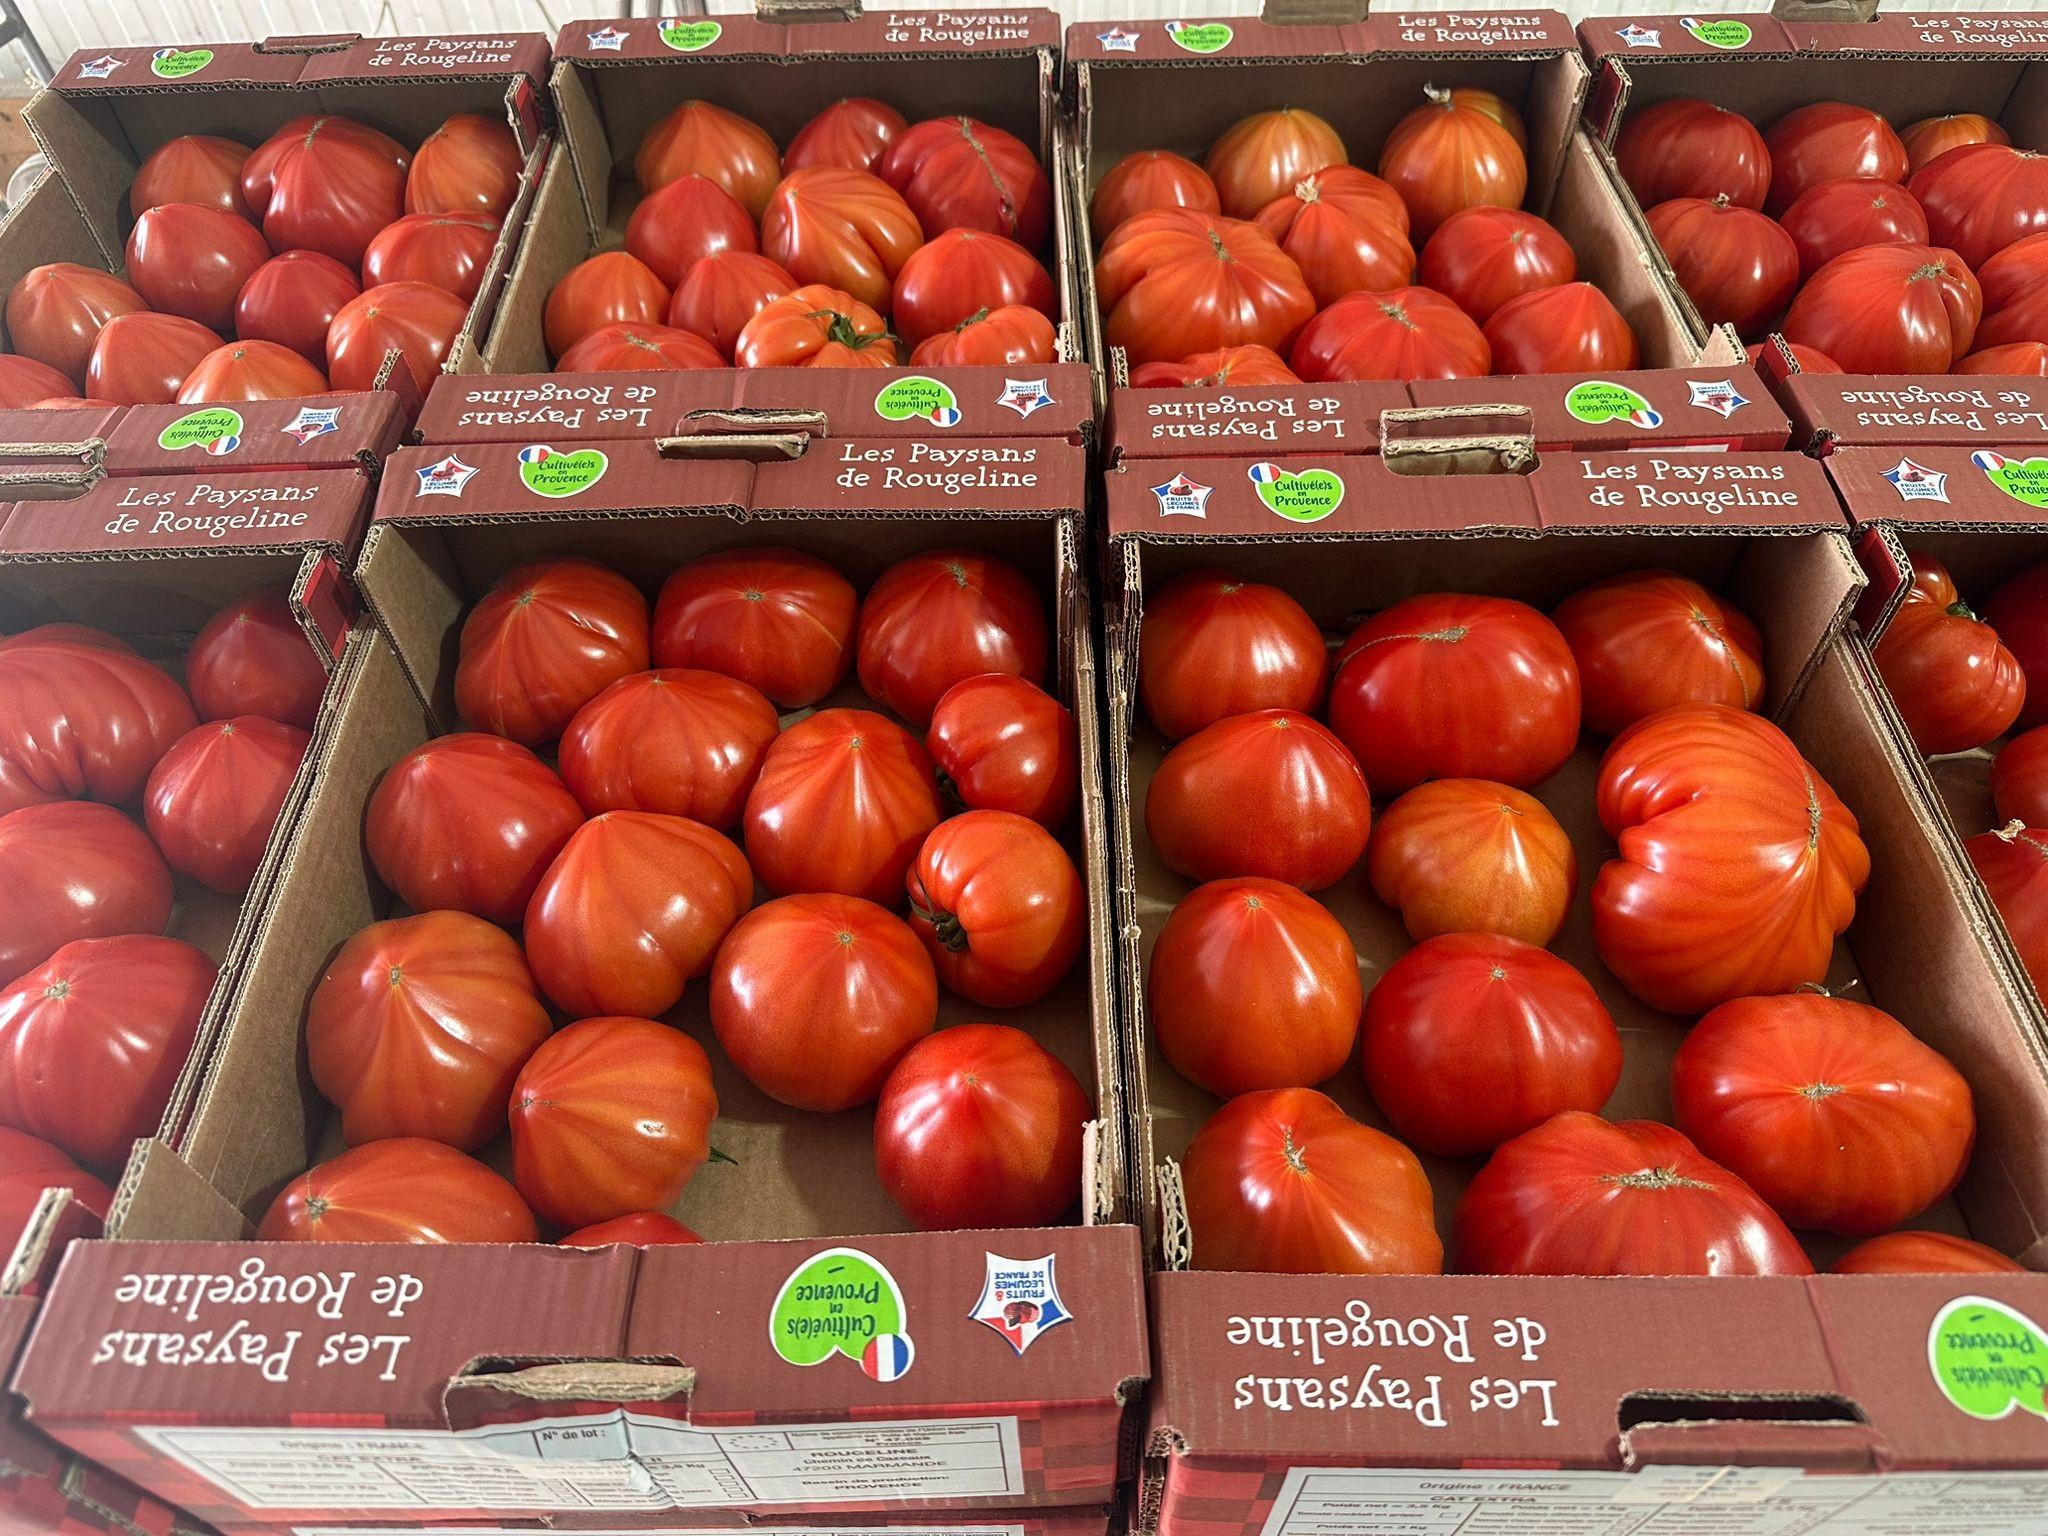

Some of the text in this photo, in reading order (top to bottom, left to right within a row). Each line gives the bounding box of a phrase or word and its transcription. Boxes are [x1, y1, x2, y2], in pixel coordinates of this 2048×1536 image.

[887, 13, 1029, 28] Les Paysans
[1398, 15, 1541, 29] Les Paysans
[1908, 16, 1950, 28] Les
[885, 26, 1030, 46] de Rougeline
[1401, 27, 1548, 46] de Rougeline
[1919, 31, 1945, 43] de
[374, 39, 518, 52] Les Paysans
[368, 50, 512, 68] de Rougeline
[465, 382, 657, 409] de Rougeline
[890, 388, 941, 398] Provence
[1575, 392, 1629, 402] Provence
[1840, 385, 2031, 410] de Rougeline
[458, 405, 652, 429] Les Paysans
[1147, 395, 1341, 421] de Rougeline
[180, 417, 234, 428] Provence
[1856, 408, 1987, 431] Paysans
[1151, 418, 1345, 441] Les Paysans
[839, 443, 1037, 468] Les Paysans
[532, 474, 589, 485] Provence
[836, 465, 1039, 495] de Rougeline
[1580, 459, 1785, 485] Les Paysans
[117, 484, 320, 510] Les Paysans
[1275, 495, 1332, 507] Provence
[1588, 483, 1800, 516] de Rougeline
[105, 509, 309, 540] de Rougeline
[995, 1271, 1044, 1280] DE FRANCE
[114, 1257, 425, 1323] de Rougeline
[795, 1280, 880, 1303] Provence
[1006, 1290, 1045, 1299] FRUITS
[829, 1303, 844, 1314] en
[786, 1314, 877, 1341] Cultivé(e)s
[1225, 1299, 1548, 1366] de Rougeline
[91, 1320, 412, 1383] Les Paysans
[1233, 1364, 1561, 1428] Les Paysans
[542, 1430, 558, 1441] N°
[562, 1429, 578, 1440] de
[581, 1428, 597, 1440] lot
[803, 1457, 853, 1465] Chemin
[810, 1448, 919, 1458] ROUGELINE
[792, 1460, 948, 1472] 47200 MARMANDE
[834, 1481, 923, 1490] PROVENCE
[1497, 1481, 1572, 1492] FRANCE
